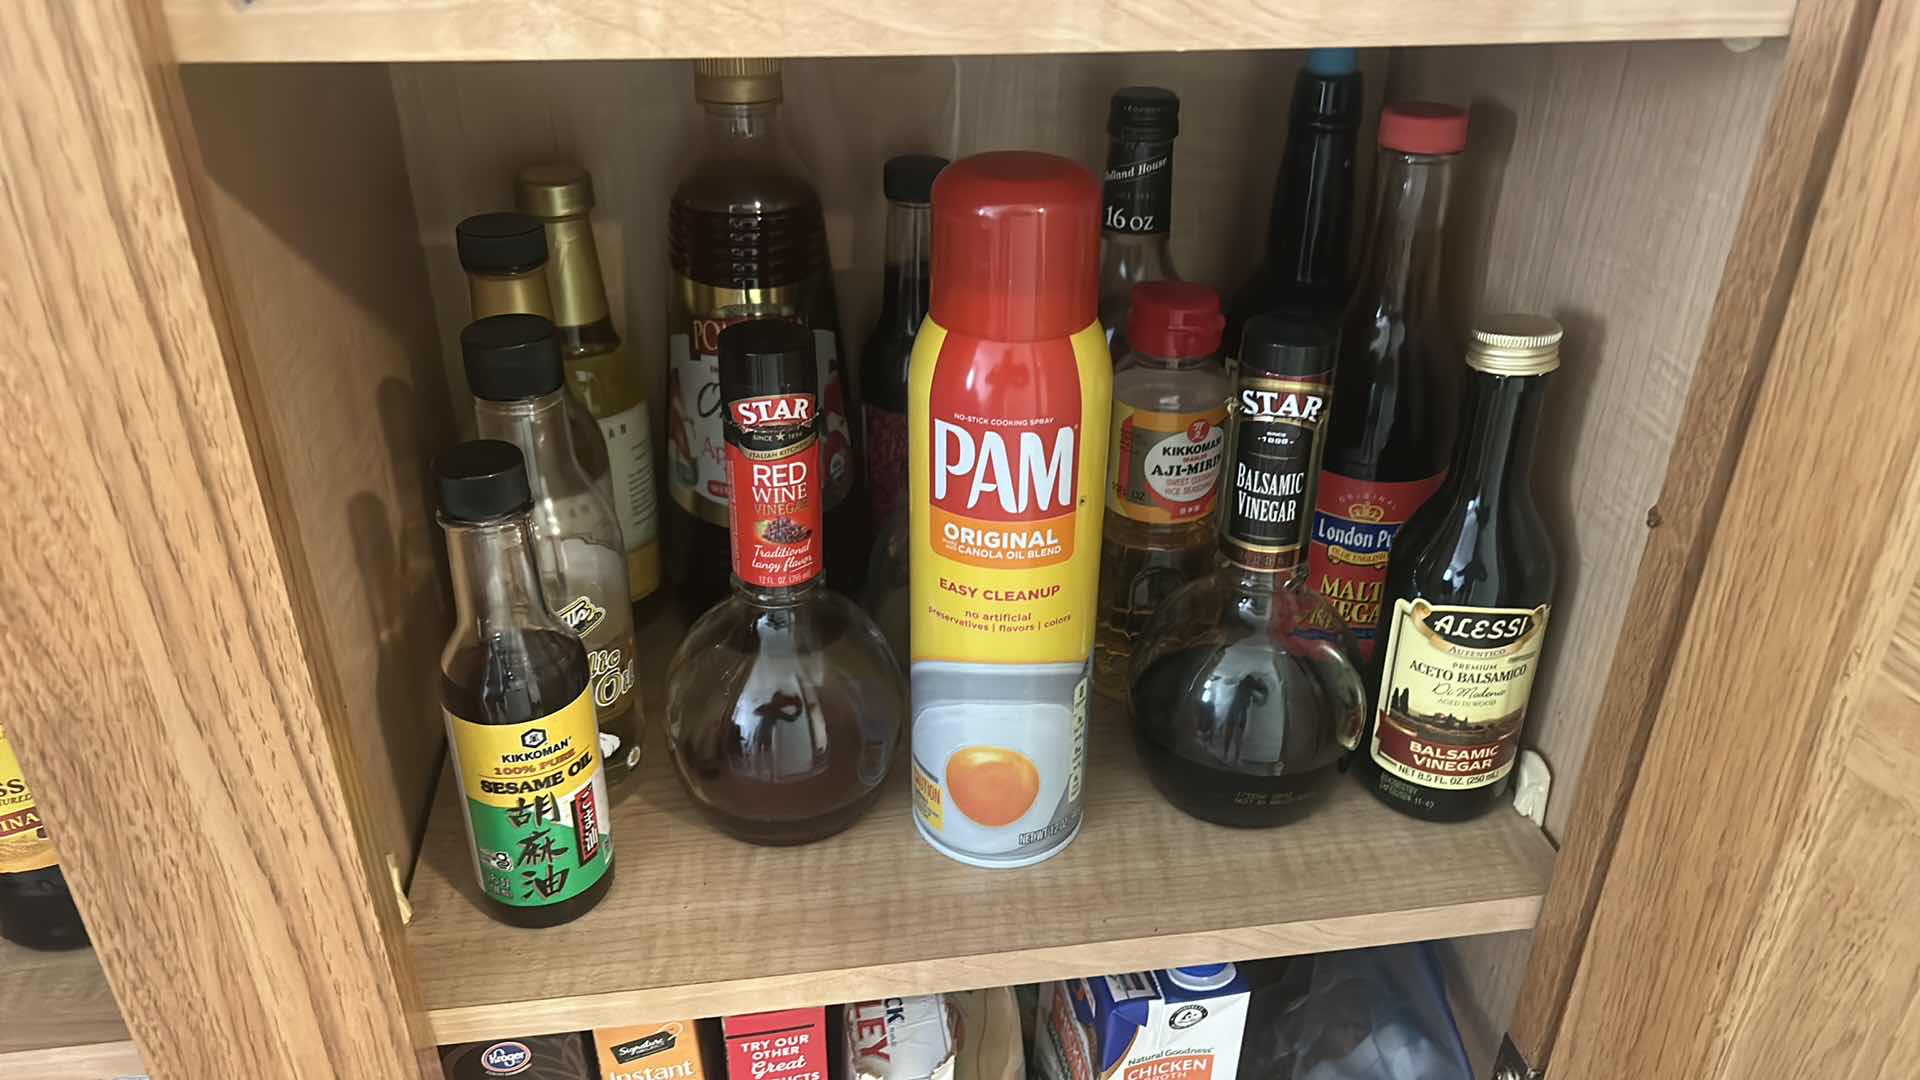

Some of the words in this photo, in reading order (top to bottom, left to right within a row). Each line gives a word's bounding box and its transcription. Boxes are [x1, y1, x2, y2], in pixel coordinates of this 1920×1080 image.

[1105, 205, 1126, 230] 16
[1130, 215, 1154, 231] oz
[738, 398, 809, 425] STAR
[1242, 389, 1323, 422] STAR
[954, 412, 989, 425] NO-STICK
[990, 418, 1028, 427] COOKING
[1030, 417, 1055, 426] SPRAY
[1162, 436, 1222, 456] KIKKOMAN
[752, 462, 807, 487] RED
[934, 418, 1075, 514] PAM
[1236, 462, 1304, 496] BALSAMIC
[751, 482, 808, 504] WINE
[1238, 490, 1297, 523] VINEGAR
[943, 522, 1058, 549] ORIGINAL
[1319, 518, 1373, 548] London
[754, 538, 811, 558] Traditional
[958, 545, 1003, 560] CANOLA
[1006, 550, 1025, 560] OIL
[1028, 545, 1061, 559] BLEND
[752, 557, 781, 573] tangy
[939, 578, 978, 600] EASY
[983, 585, 1061, 602] CLEANUP
[1320, 575, 1384, 603] MALT
[928, 605, 989, 631] preservatives
[999, 623, 1034, 633] flavors
[1044, 613, 1071, 629] colors
[965, 609, 979, 619] no
[982, 611, 1032, 623] artificial
[1434, 615, 1529, 640] ALESSI
[1449, 645, 1506, 657] AUTENTICO
[1409, 659, 1454, 682] ACETO
[1457, 663, 1527, 684] BALSAMICO
[1452, 661, 1498, 671] PREMIUM
[494, 765, 536, 775] 100%
[539, 748, 576, 770] PURE
[501, 738, 569, 763] KIKKOMAN
[1409, 740, 1499, 760] BALSAMIC
[480, 771, 565, 794] SESAME
[568, 751, 593, 777] OIL
[1398, 765, 1415, 777] NET
[1417, 772, 1432, 782] 8.5
[1412, 754, 1493, 772] VINEGAR
[507, 792, 571, 900] 胡麻油
[740, 1039, 770, 1053] TRY
[774, 1034, 809, 1047] OUR
[751, 1046, 800, 1060] OTHER
[487, 1048, 526, 1067] Kroger
[751, 1055, 807, 1079] Great
[1127, 1050, 1164, 1066] Natural
[1164, 1047, 1212, 1057] Goodness
[609, 1060, 695, 1080] Instant
[1127, 1058, 1207, 1080] CHICKEN
